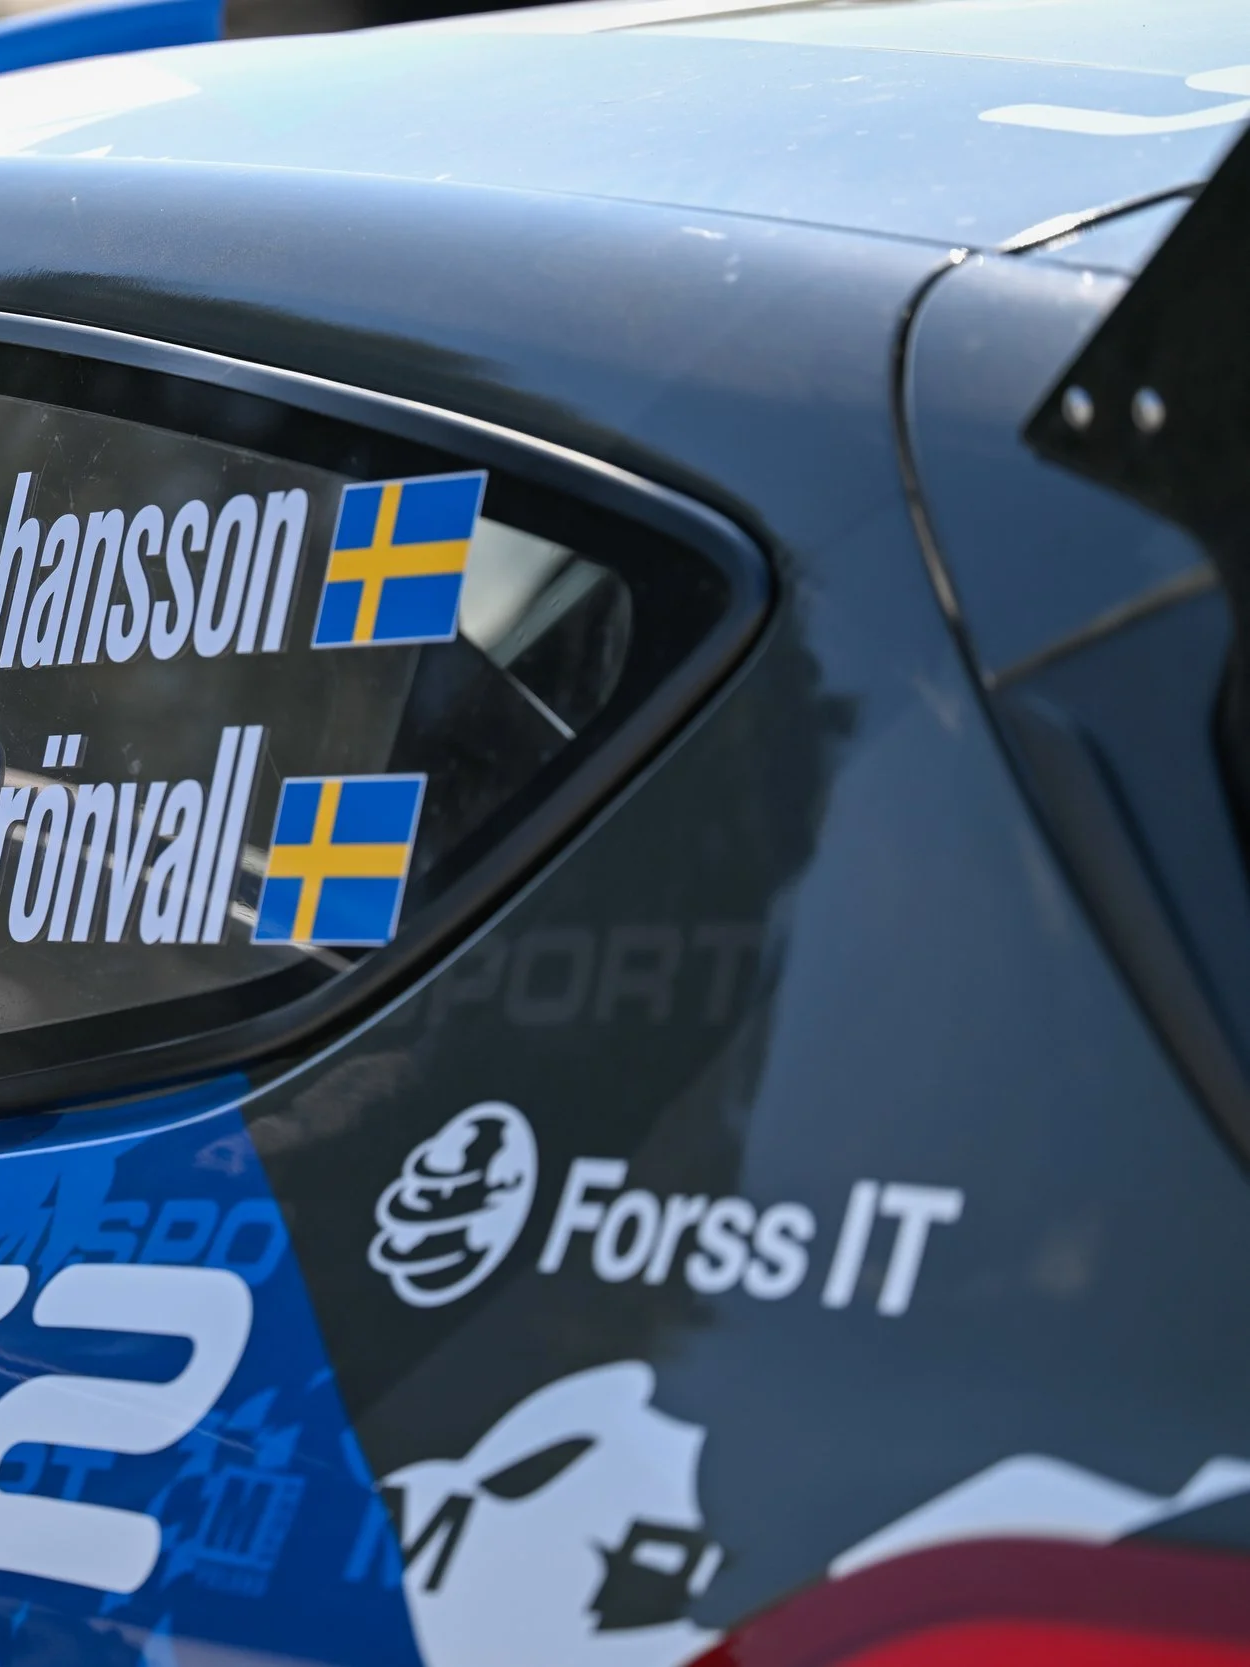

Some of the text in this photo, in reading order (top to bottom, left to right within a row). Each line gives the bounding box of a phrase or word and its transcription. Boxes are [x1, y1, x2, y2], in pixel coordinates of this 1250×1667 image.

[379, 922, 764, 1028] PORT
[537, 1156, 965, 1318] Forss IT
